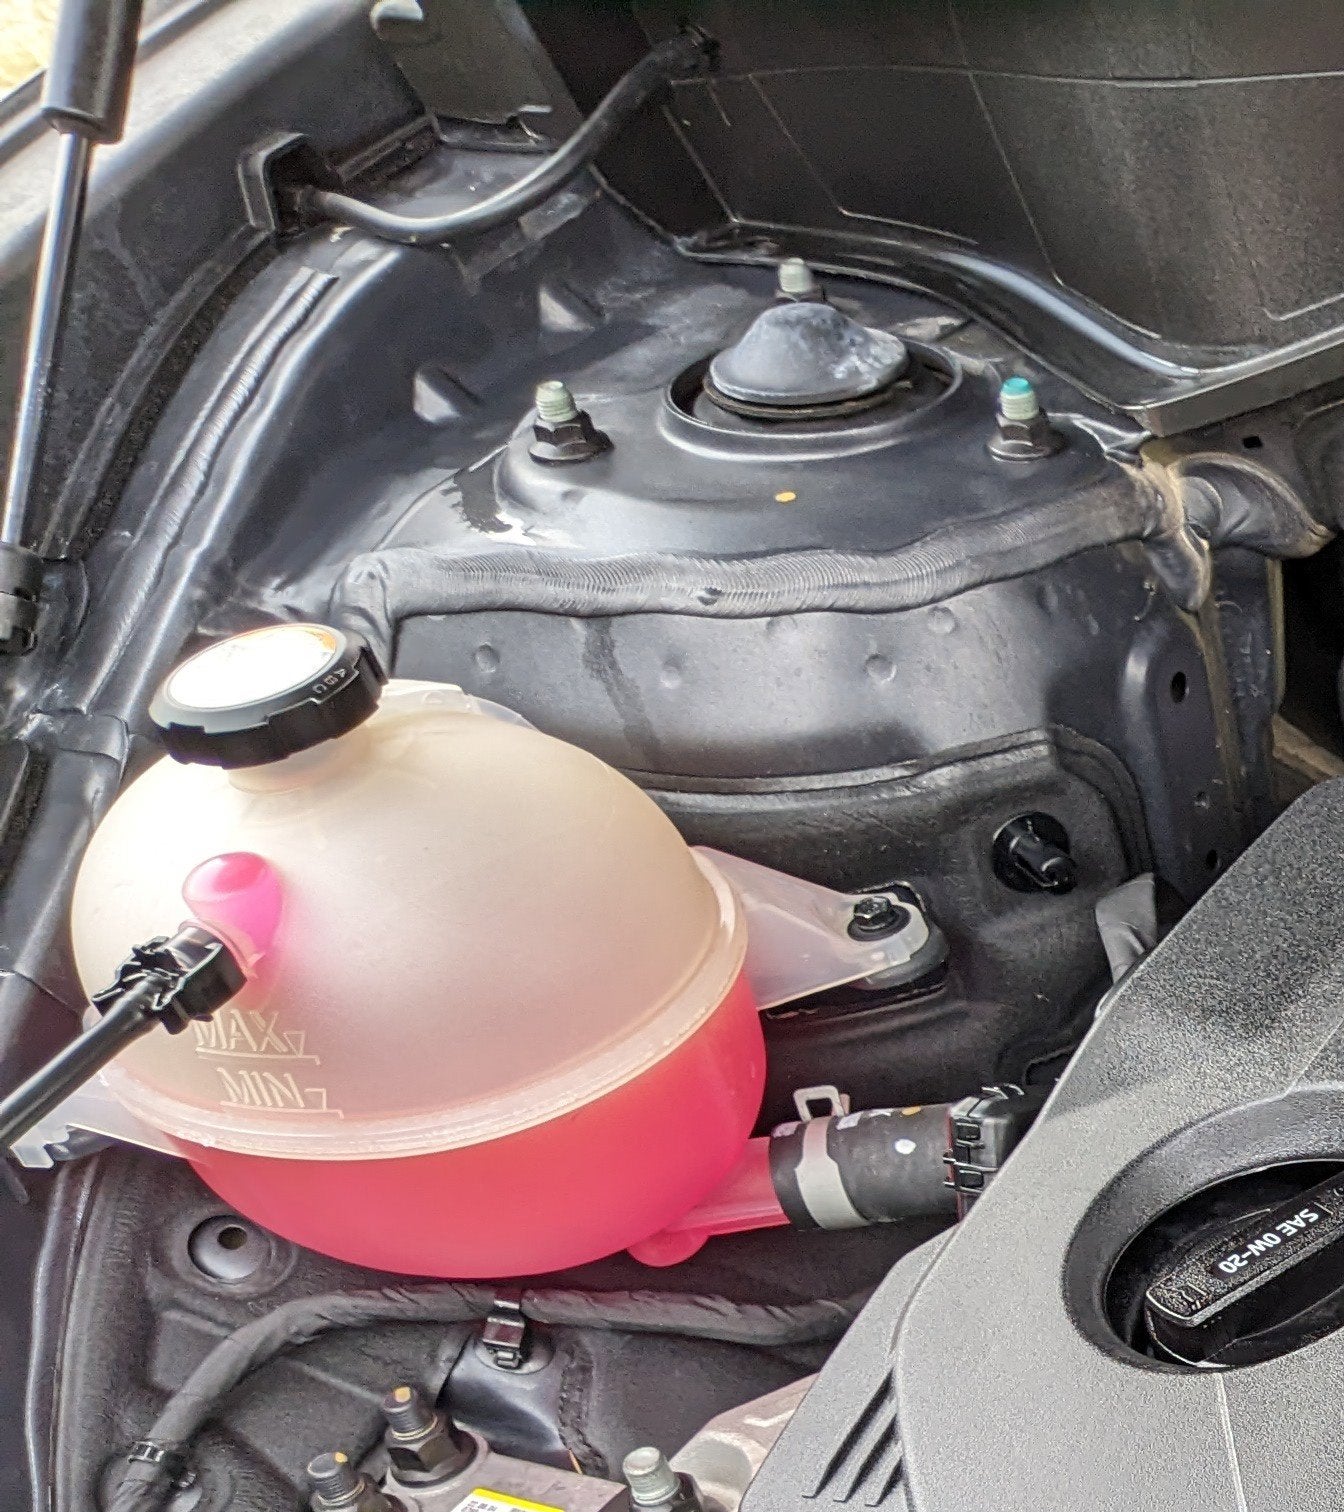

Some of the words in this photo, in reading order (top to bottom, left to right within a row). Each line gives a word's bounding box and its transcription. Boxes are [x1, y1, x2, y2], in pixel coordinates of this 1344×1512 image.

[193, 1009, 288, 1053] MAX
[216, 1067, 305, 1108] MIN
[1277, 1208, 1319, 1238] SAE
[1218, 1231, 1282, 1274] 0W-20
